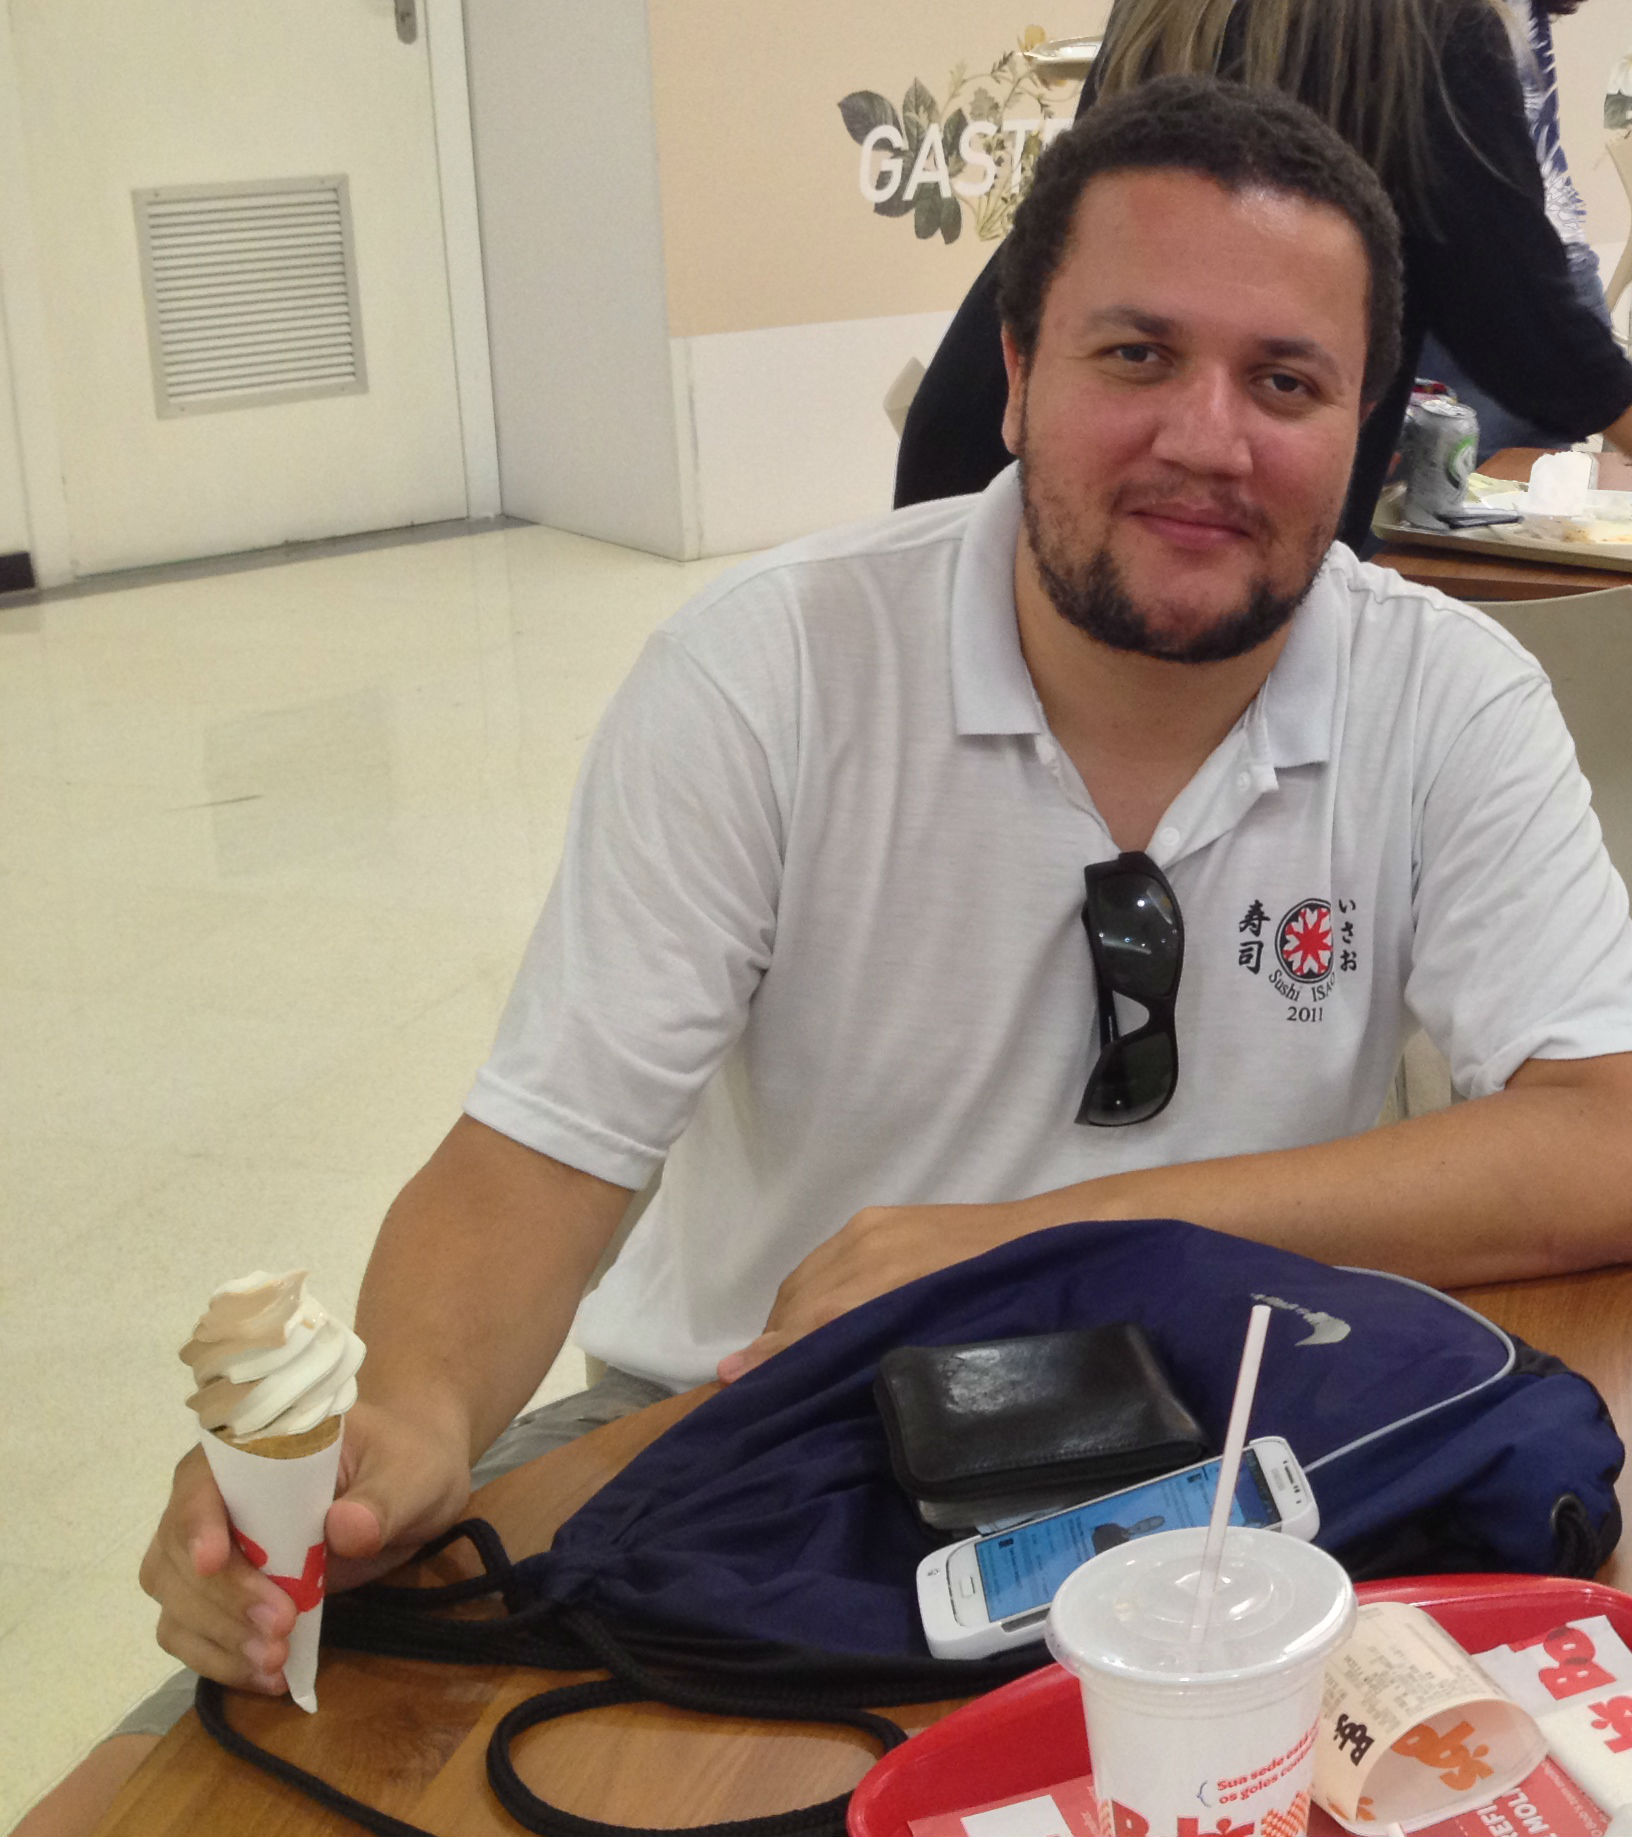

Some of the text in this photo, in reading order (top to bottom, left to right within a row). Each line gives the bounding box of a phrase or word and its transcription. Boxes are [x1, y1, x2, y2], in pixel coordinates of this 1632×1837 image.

[1238, 899, 1271, 975] 寿司
[1338, 898, 1357, 972] いさお
[1268, 969, 1300, 1002] Sushi
[1286, 1006, 1323, 1022] 2011
[1333, 1712, 1375, 1767] Bob's
